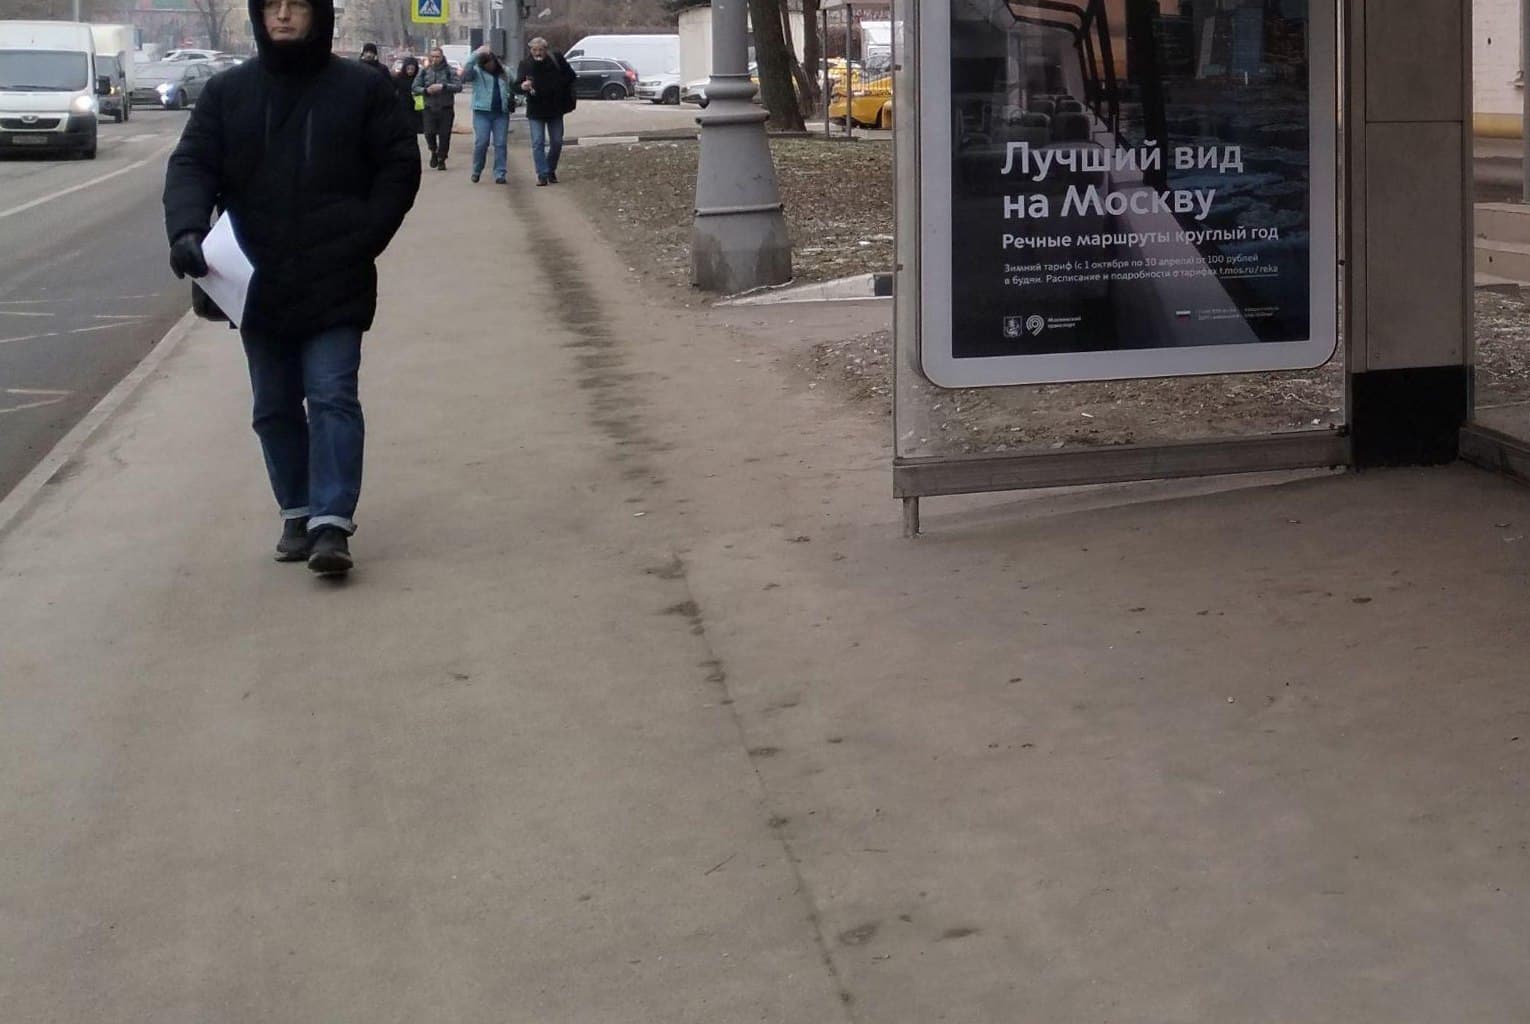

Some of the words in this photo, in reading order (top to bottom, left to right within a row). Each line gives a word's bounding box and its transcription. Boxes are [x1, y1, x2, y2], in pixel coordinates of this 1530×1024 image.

[1000, 140, 1162, 182] Лучший
[1174, 144, 1244, 174] вид
[1002, 192, 1050, 220] на
[1060, 183, 1217, 221] Москву
[1002, 233, 1072, 250] Речные
[1076, 231, 1171, 248] маршруты
[1174, 224, 1247, 245] круглый
[1250, 227, 1279, 241] год
[1044, 261, 1073, 271] тариф
[1091, 258, 1129, 270] октября
[1131, 259, 1143, 268] по
[1207, 255, 1225, 264] 100
[1226, 253, 1259, 265] рублей
[1046, 274, 1101, 283] Расписание
[1111, 269, 1171, 281] подробности
[1219, 263, 1280, 275] t.mos.ru/reka
